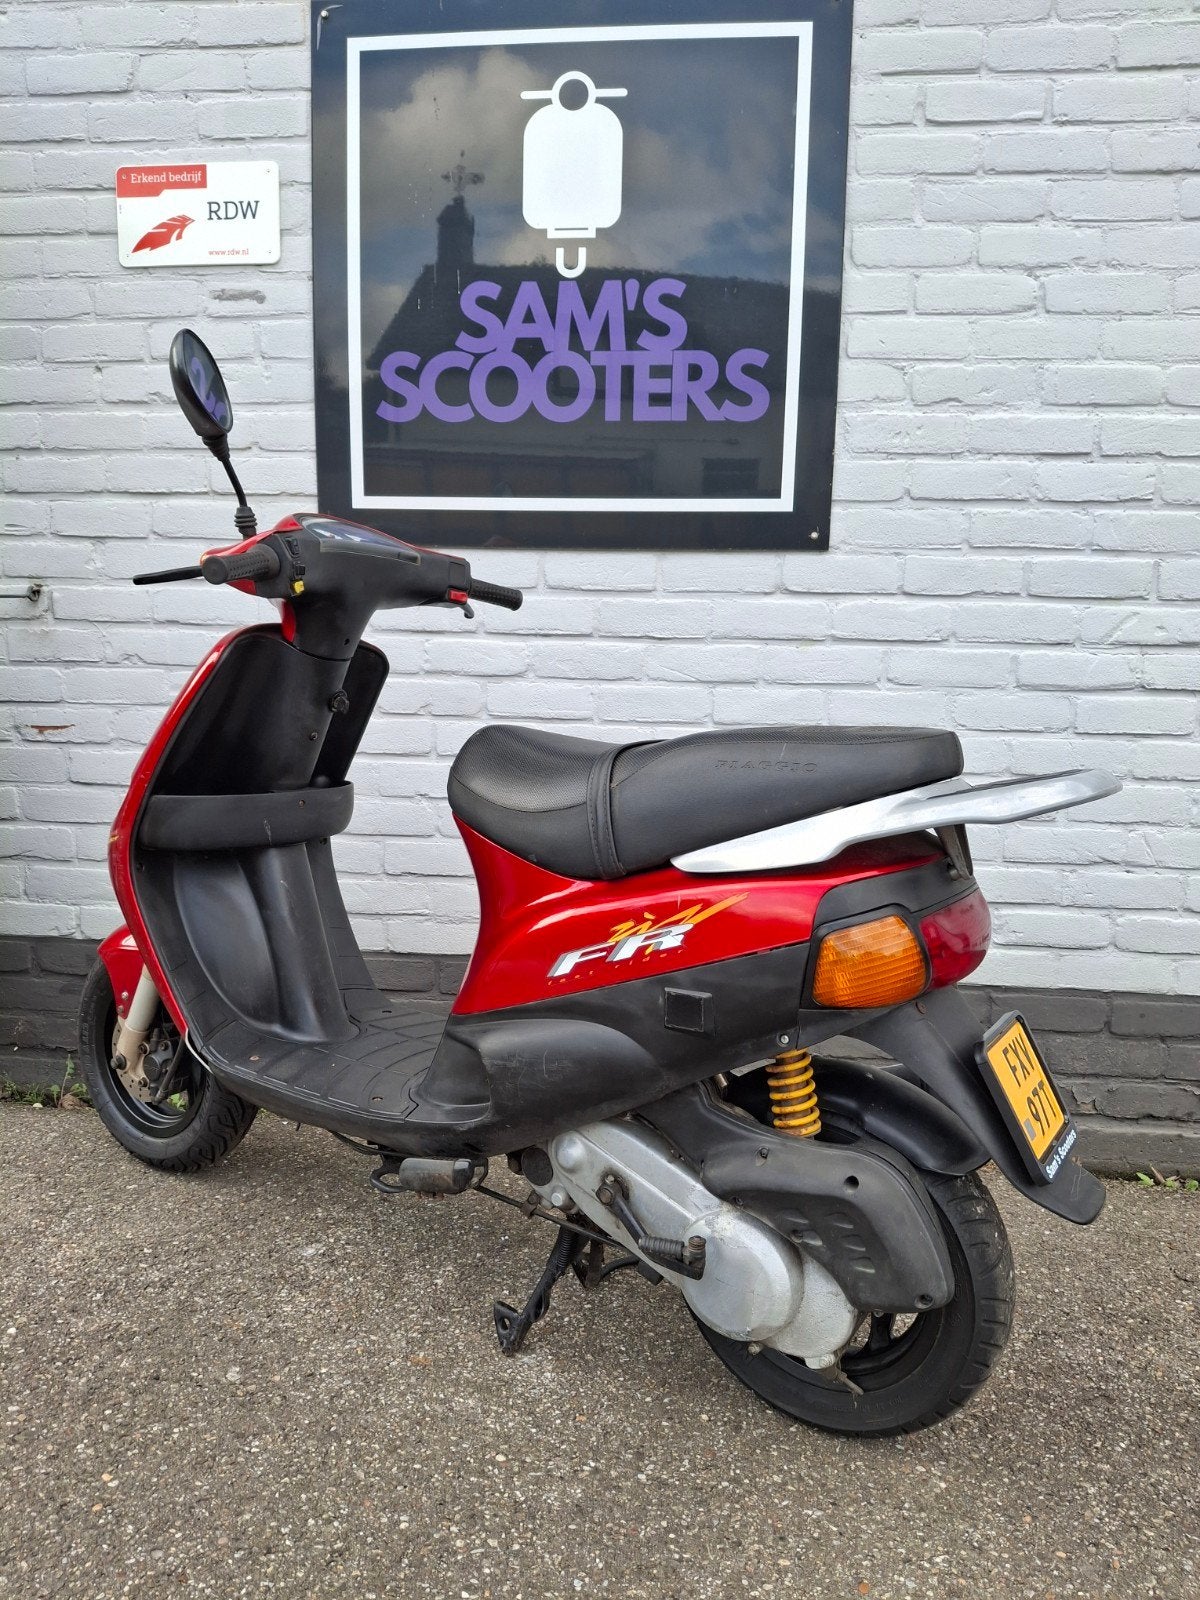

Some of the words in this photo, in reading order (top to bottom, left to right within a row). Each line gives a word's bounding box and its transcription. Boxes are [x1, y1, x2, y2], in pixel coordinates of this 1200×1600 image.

[130, 173, 166, 183] Erkend
[169, 171, 202, 182] bedrijf
[207, 200, 260, 220] RDW
[208, 248, 249, 256] www.rdw.nl
[455, 278, 687, 353] SAM'S
[376, 348, 770, 423] SCOOTERS
[715, 760, 818, 772] PIAGGIO
[547, 923, 694, 978] FR
[1002, 1033, 1034, 1088] FXV
[1026, 1080, 1057, 1136] 977
[1045, 1155, 1061, 1179] Sam's
[1058, 1129, 1077, 1158] Scooters
